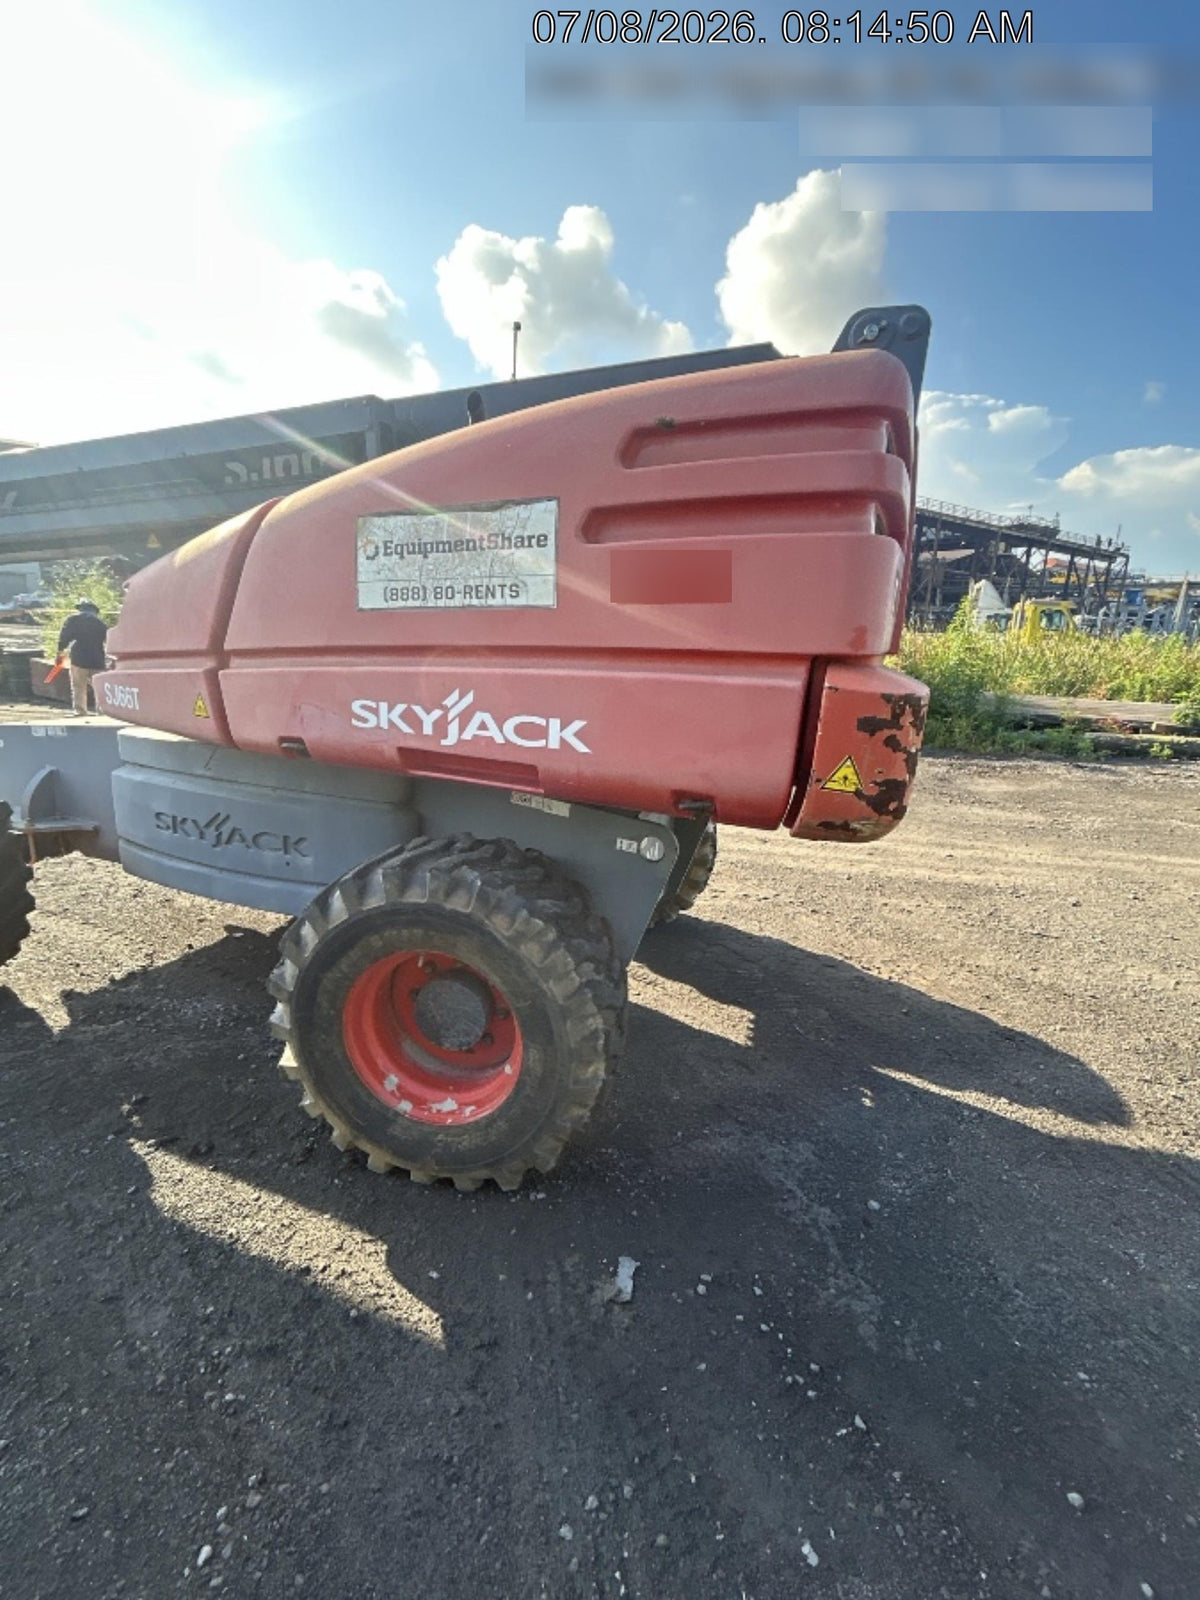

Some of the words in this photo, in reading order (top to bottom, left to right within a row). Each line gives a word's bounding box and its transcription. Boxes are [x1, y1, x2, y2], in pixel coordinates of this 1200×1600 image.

[382, 532, 549, 559] EquipmentShare
[383, 585, 428, 603] (888)
[433, 583, 521, 600] 80-RENTS
[103, 681, 139, 711] SJ66T
[350, 687, 593, 753] SKYJACK
[153, 811, 311, 858] SKYJACK
